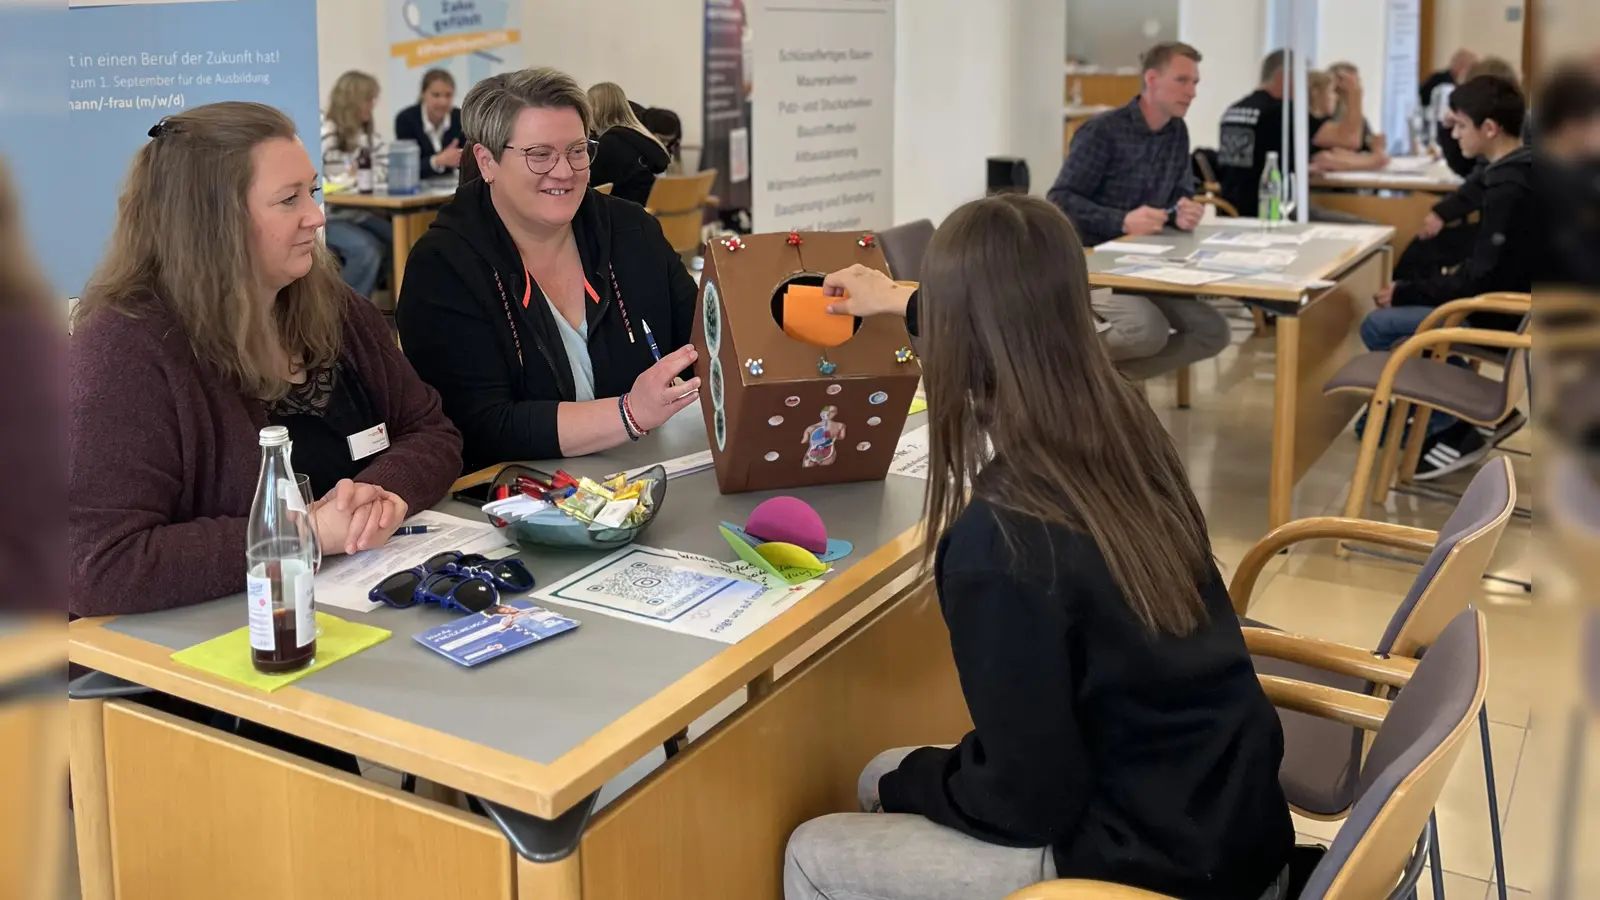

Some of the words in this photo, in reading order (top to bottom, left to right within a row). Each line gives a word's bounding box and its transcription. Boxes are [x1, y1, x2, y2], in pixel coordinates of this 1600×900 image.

[80, 53, 93, 67] in
[97, 53, 137, 66] einen
[141, 51, 179, 66] Beruf
[181, 51, 203, 65] der
[206, 49, 253, 65] Zukunft
[256, 49, 280, 64] hat!
[70, 78, 96, 89] zum
[100, 76, 110, 88] 1.
[113, 73, 174, 89] September
[178, 73, 193, 85] für
[196, 73, 212, 84] die
[215, 72, 270, 85] Ausbildung
[136, 93, 185, 110] (m/w/d)
[709, 618, 732, 633] Folge
[731, 608, 744, 618] uns
